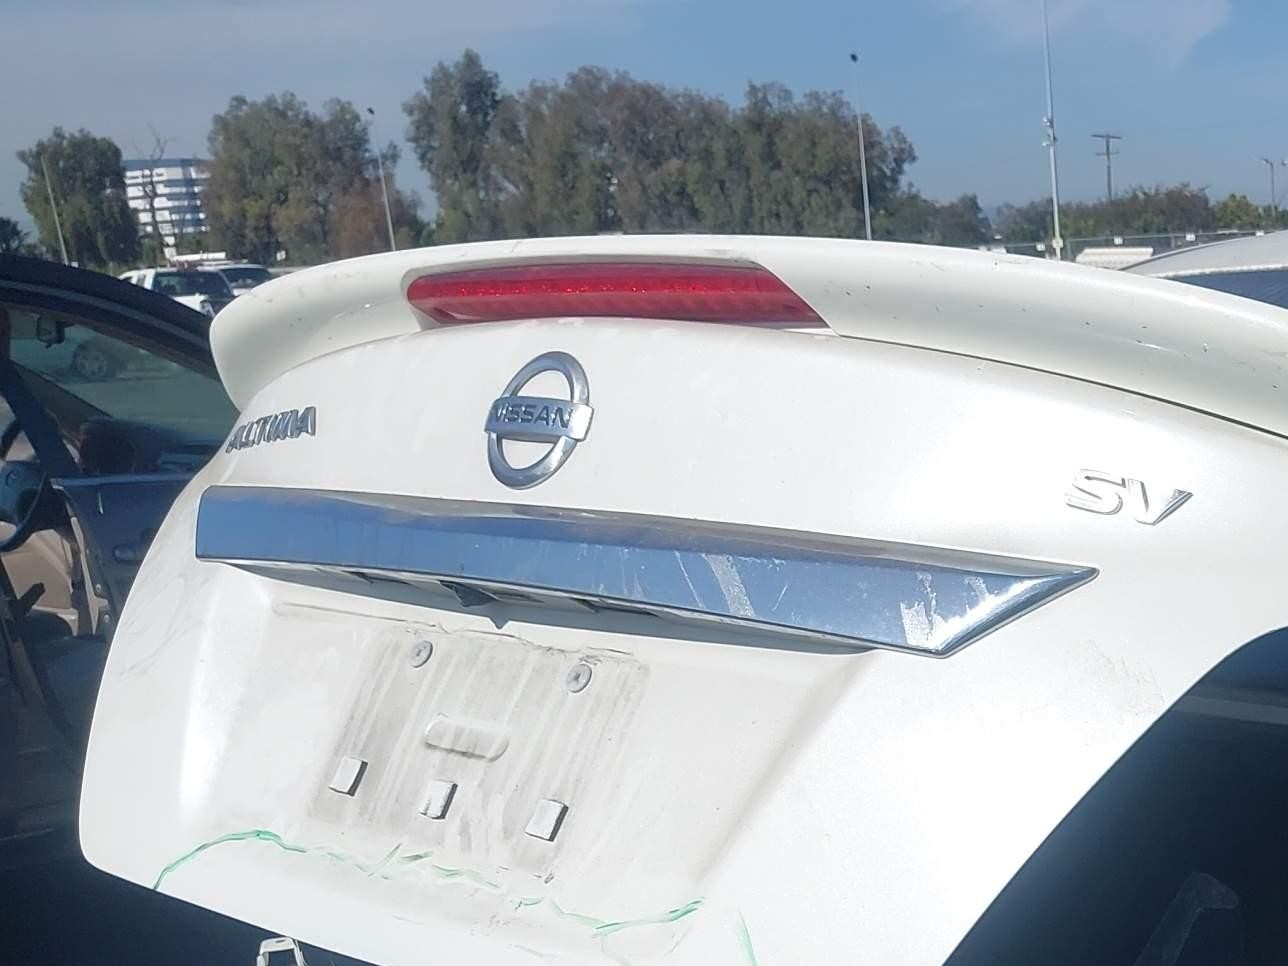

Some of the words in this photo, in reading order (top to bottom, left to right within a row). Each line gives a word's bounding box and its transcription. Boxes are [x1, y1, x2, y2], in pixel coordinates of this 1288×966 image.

[225, 406, 316, 454] ALTIMA
[494, 402, 574, 429] NISSAN
[1064, 468, 1193, 526] SV
